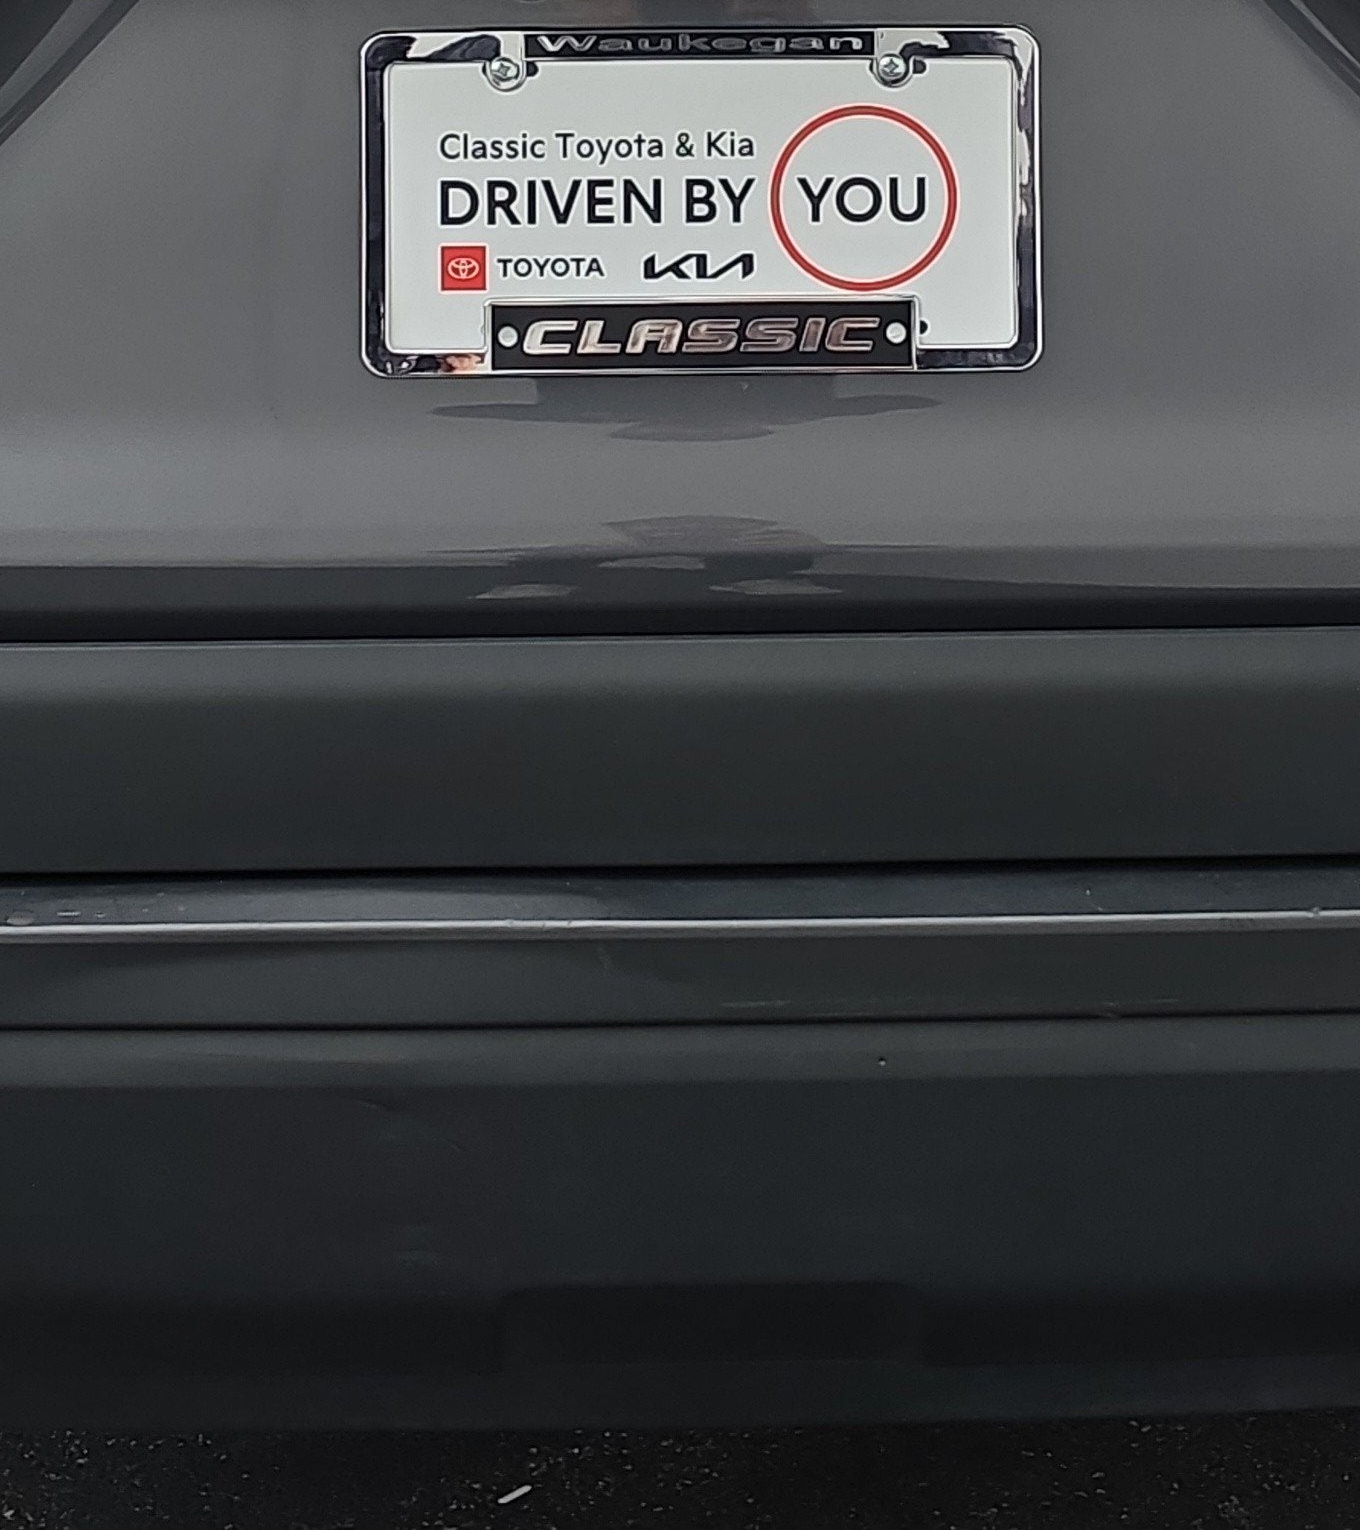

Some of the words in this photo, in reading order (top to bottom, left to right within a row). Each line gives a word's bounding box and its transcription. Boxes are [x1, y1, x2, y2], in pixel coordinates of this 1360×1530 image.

[537, 34, 862, 53] Waukegan
[439, 133, 546, 159] Classic
[555, 132, 663, 164] Toyota
[675, 132, 694, 157] &
[706, 131, 755, 157] Kia
[439, 178, 662, 225] DRIVEN
[685, 178, 756, 224] BY
[797, 177, 926, 222] YOU
[497, 258, 605, 278] TOYOTA
[643, 253, 755, 280] KIA
[522, 317, 881, 355] CLASSIC
